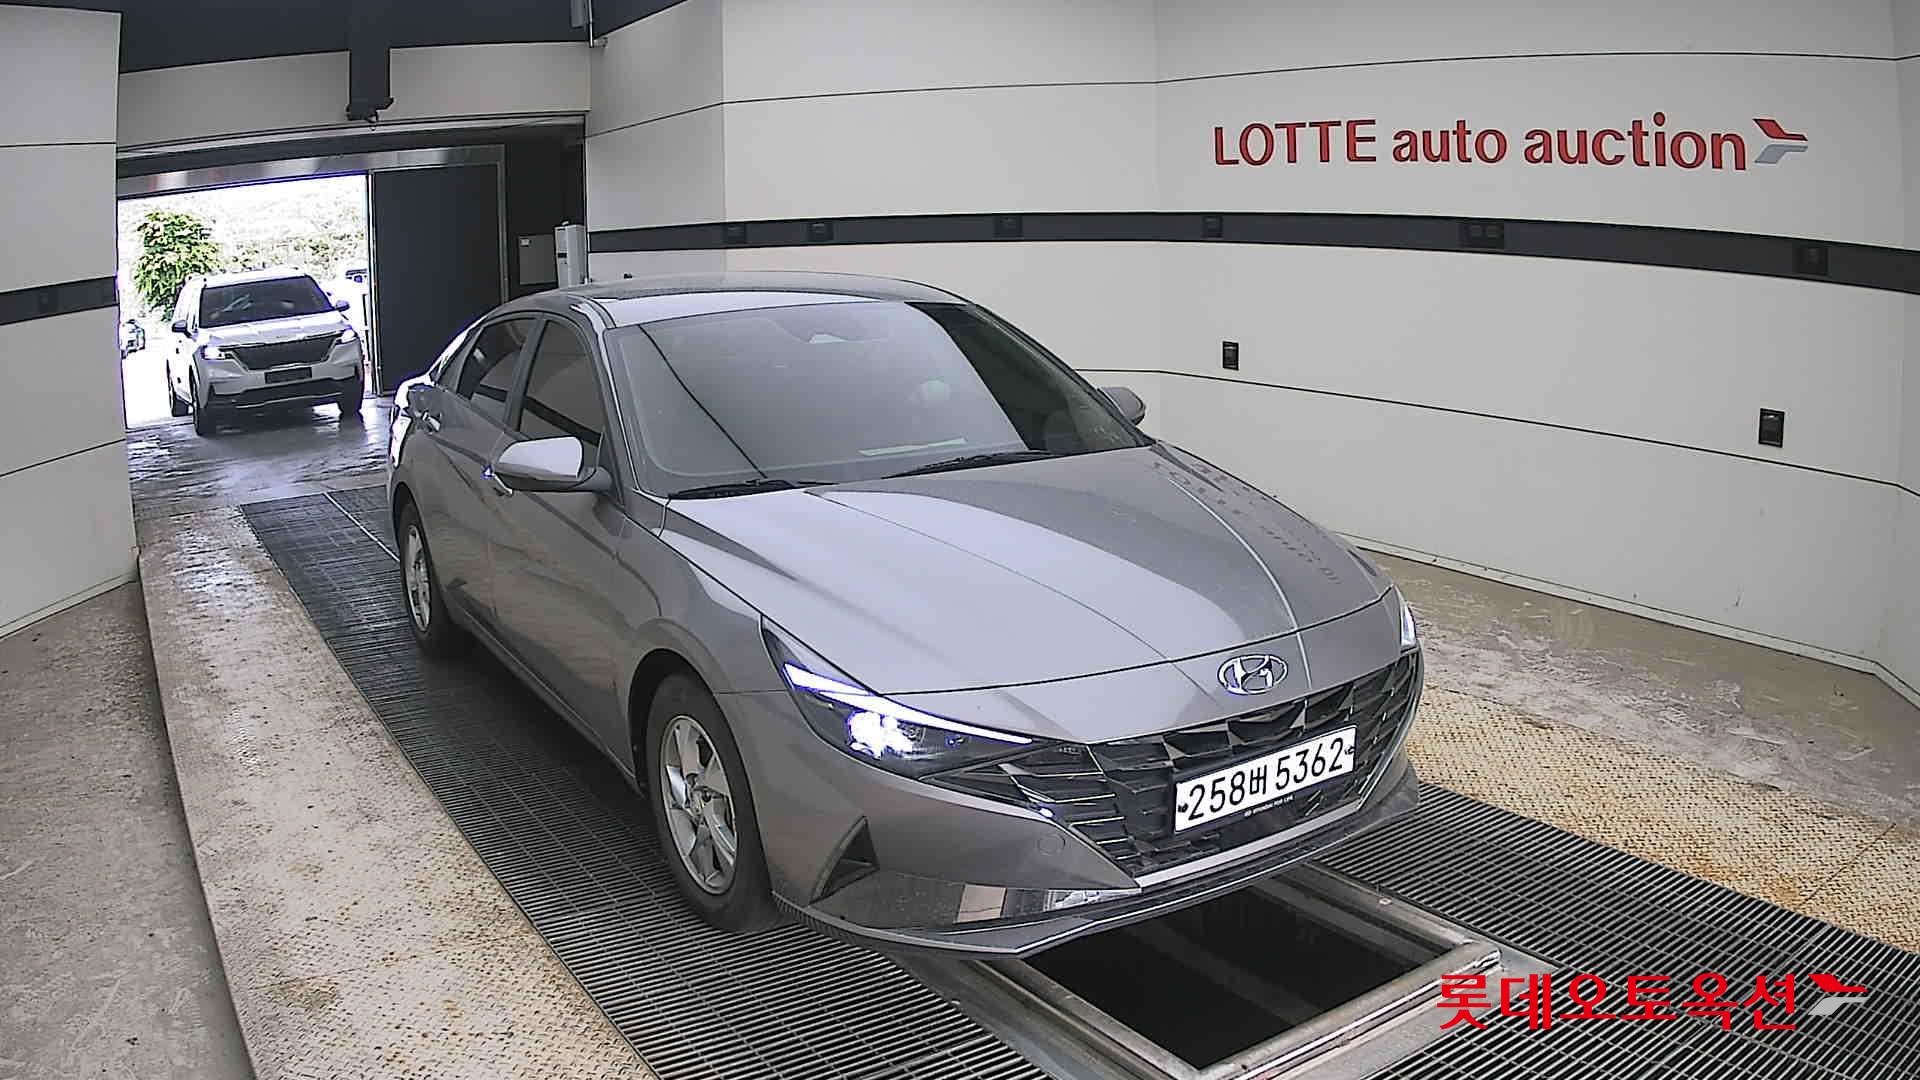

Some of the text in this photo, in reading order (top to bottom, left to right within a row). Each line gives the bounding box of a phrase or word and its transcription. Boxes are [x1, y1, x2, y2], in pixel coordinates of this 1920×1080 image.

[1213, 111, 1747, 171] LOTTE auto auction
[1187, 764, 1268, 821] 258버
[1275, 737, 1344, 791] 5362
